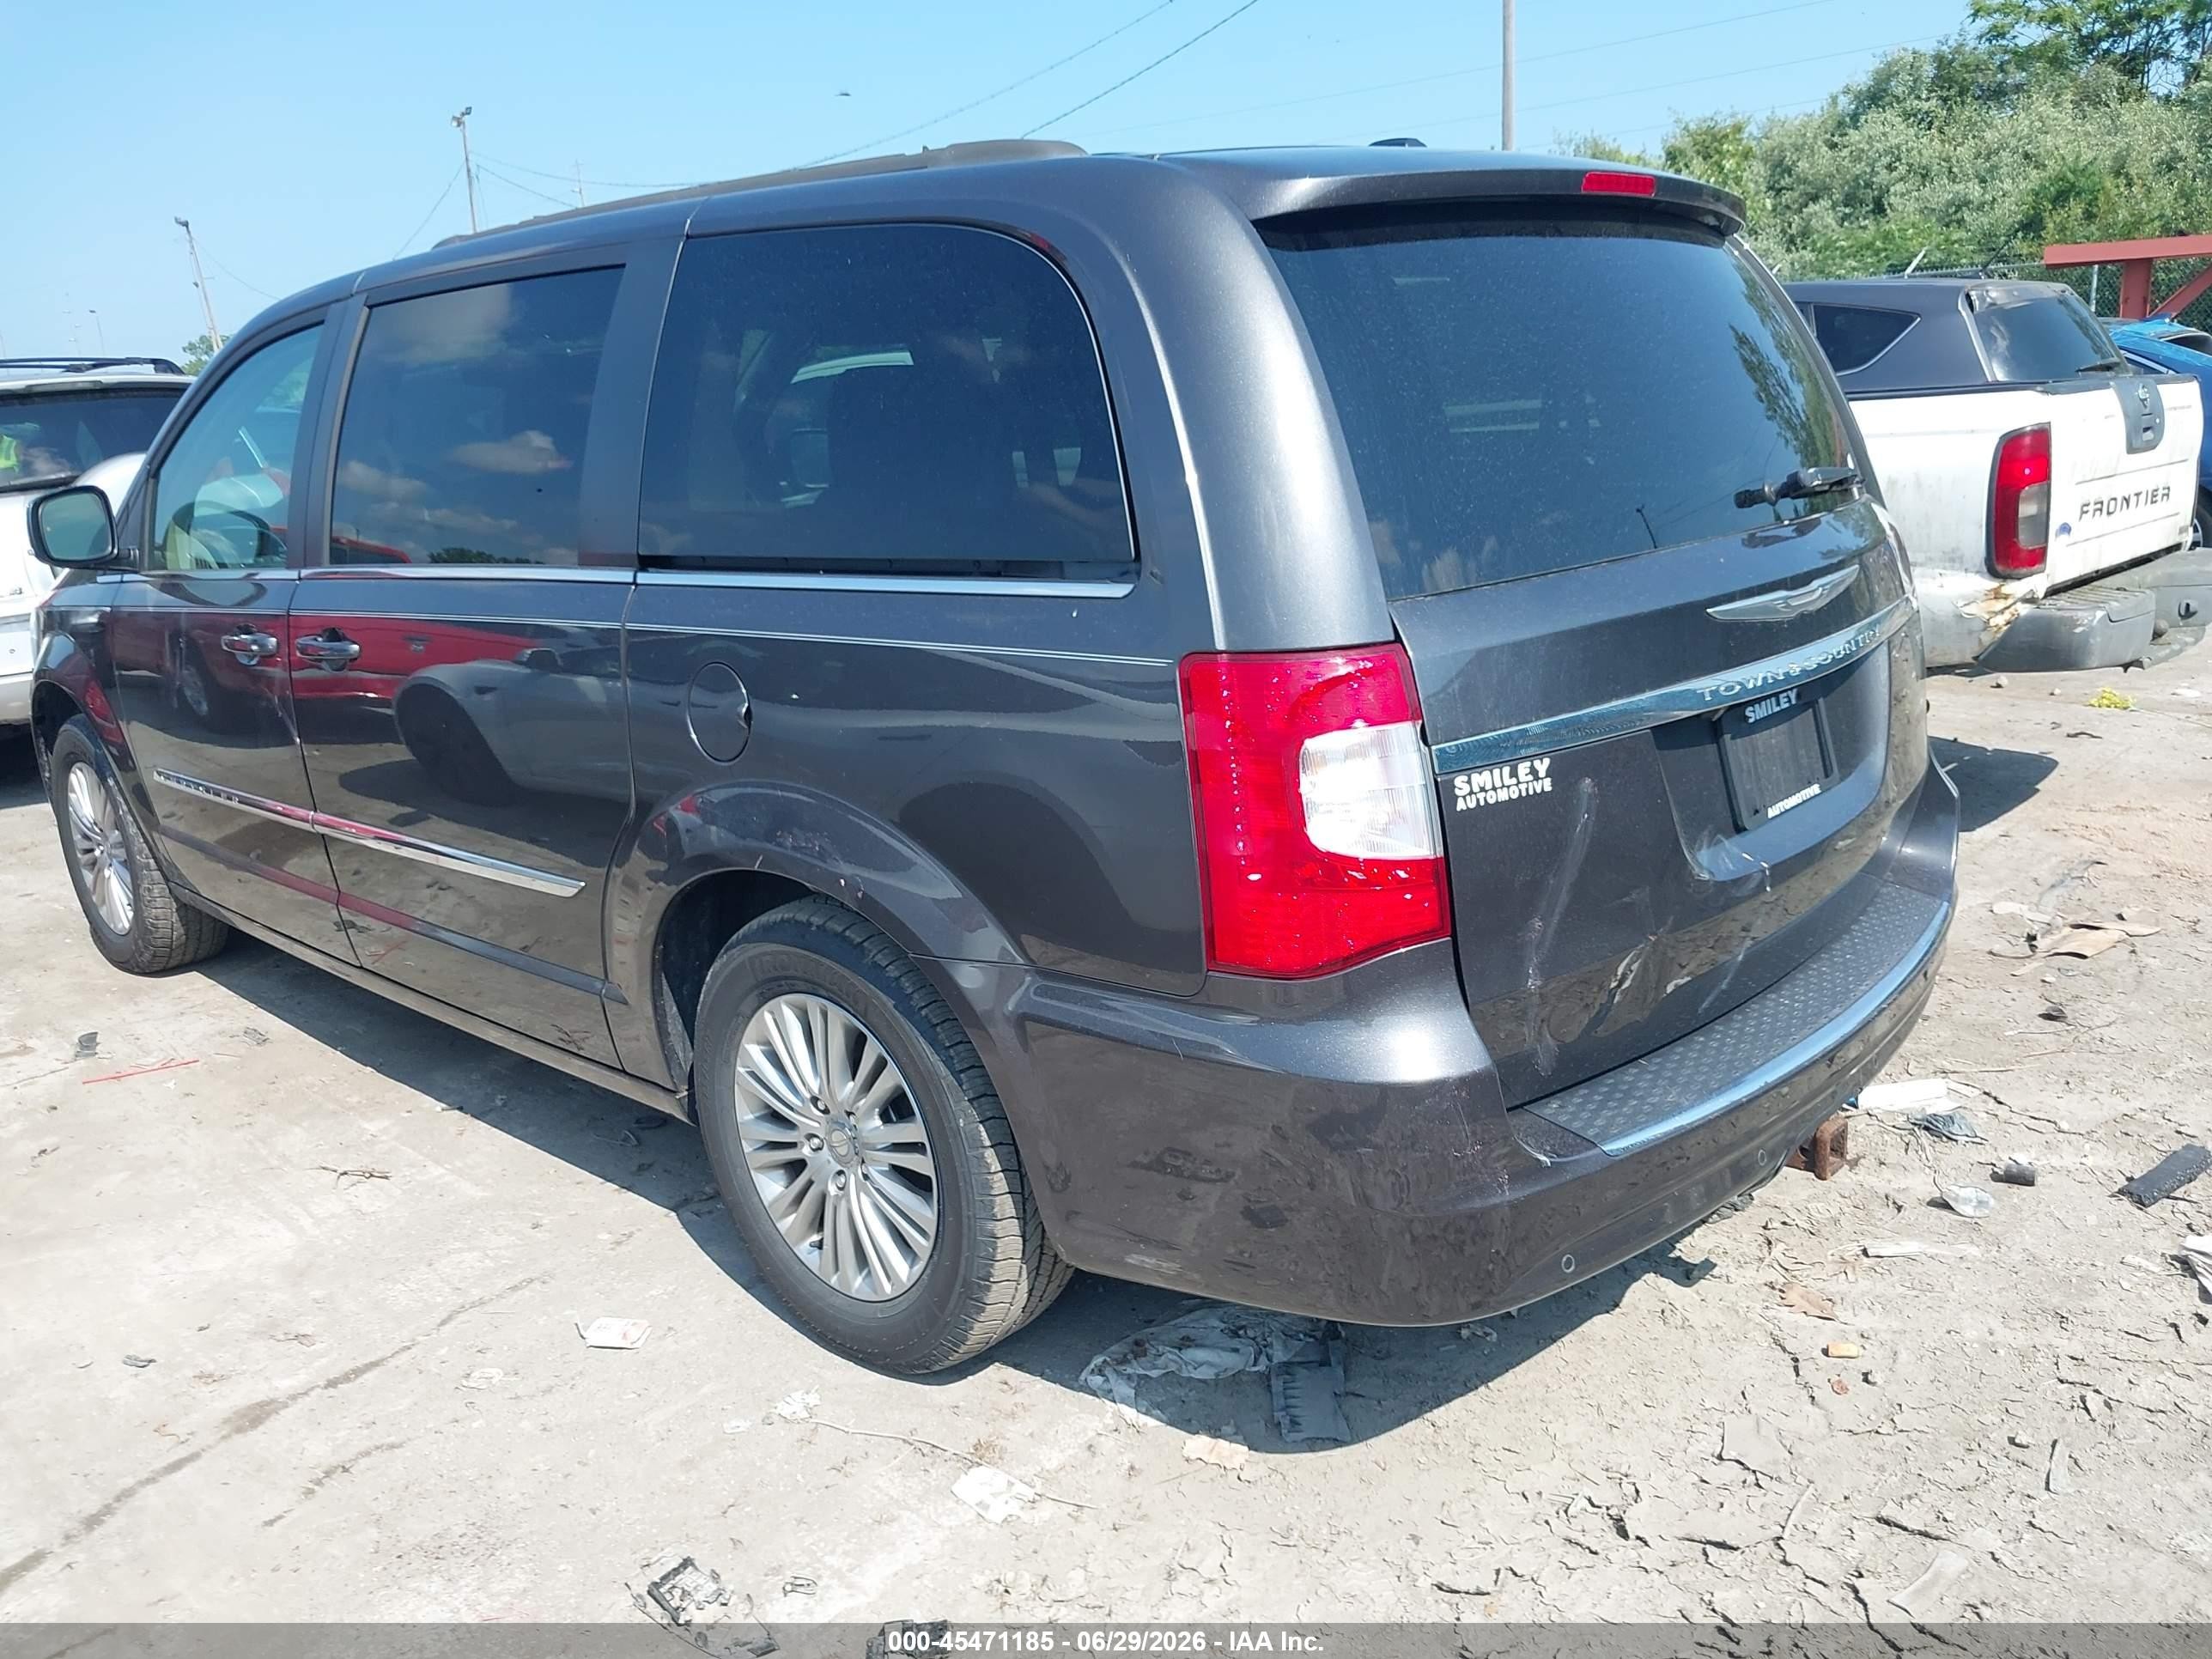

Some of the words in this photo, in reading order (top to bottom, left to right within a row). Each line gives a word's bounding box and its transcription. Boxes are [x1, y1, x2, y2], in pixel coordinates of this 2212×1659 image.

[2078, 485, 2171, 522] FRONTIER
[1744, 688, 1799, 724] SMILEY
[1454, 757, 1551, 797] SMILEY
[1455, 777, 1553, 811] AUTOMOTIVE
[1767, 783, 1822, 819] AUTOMOTIVE
